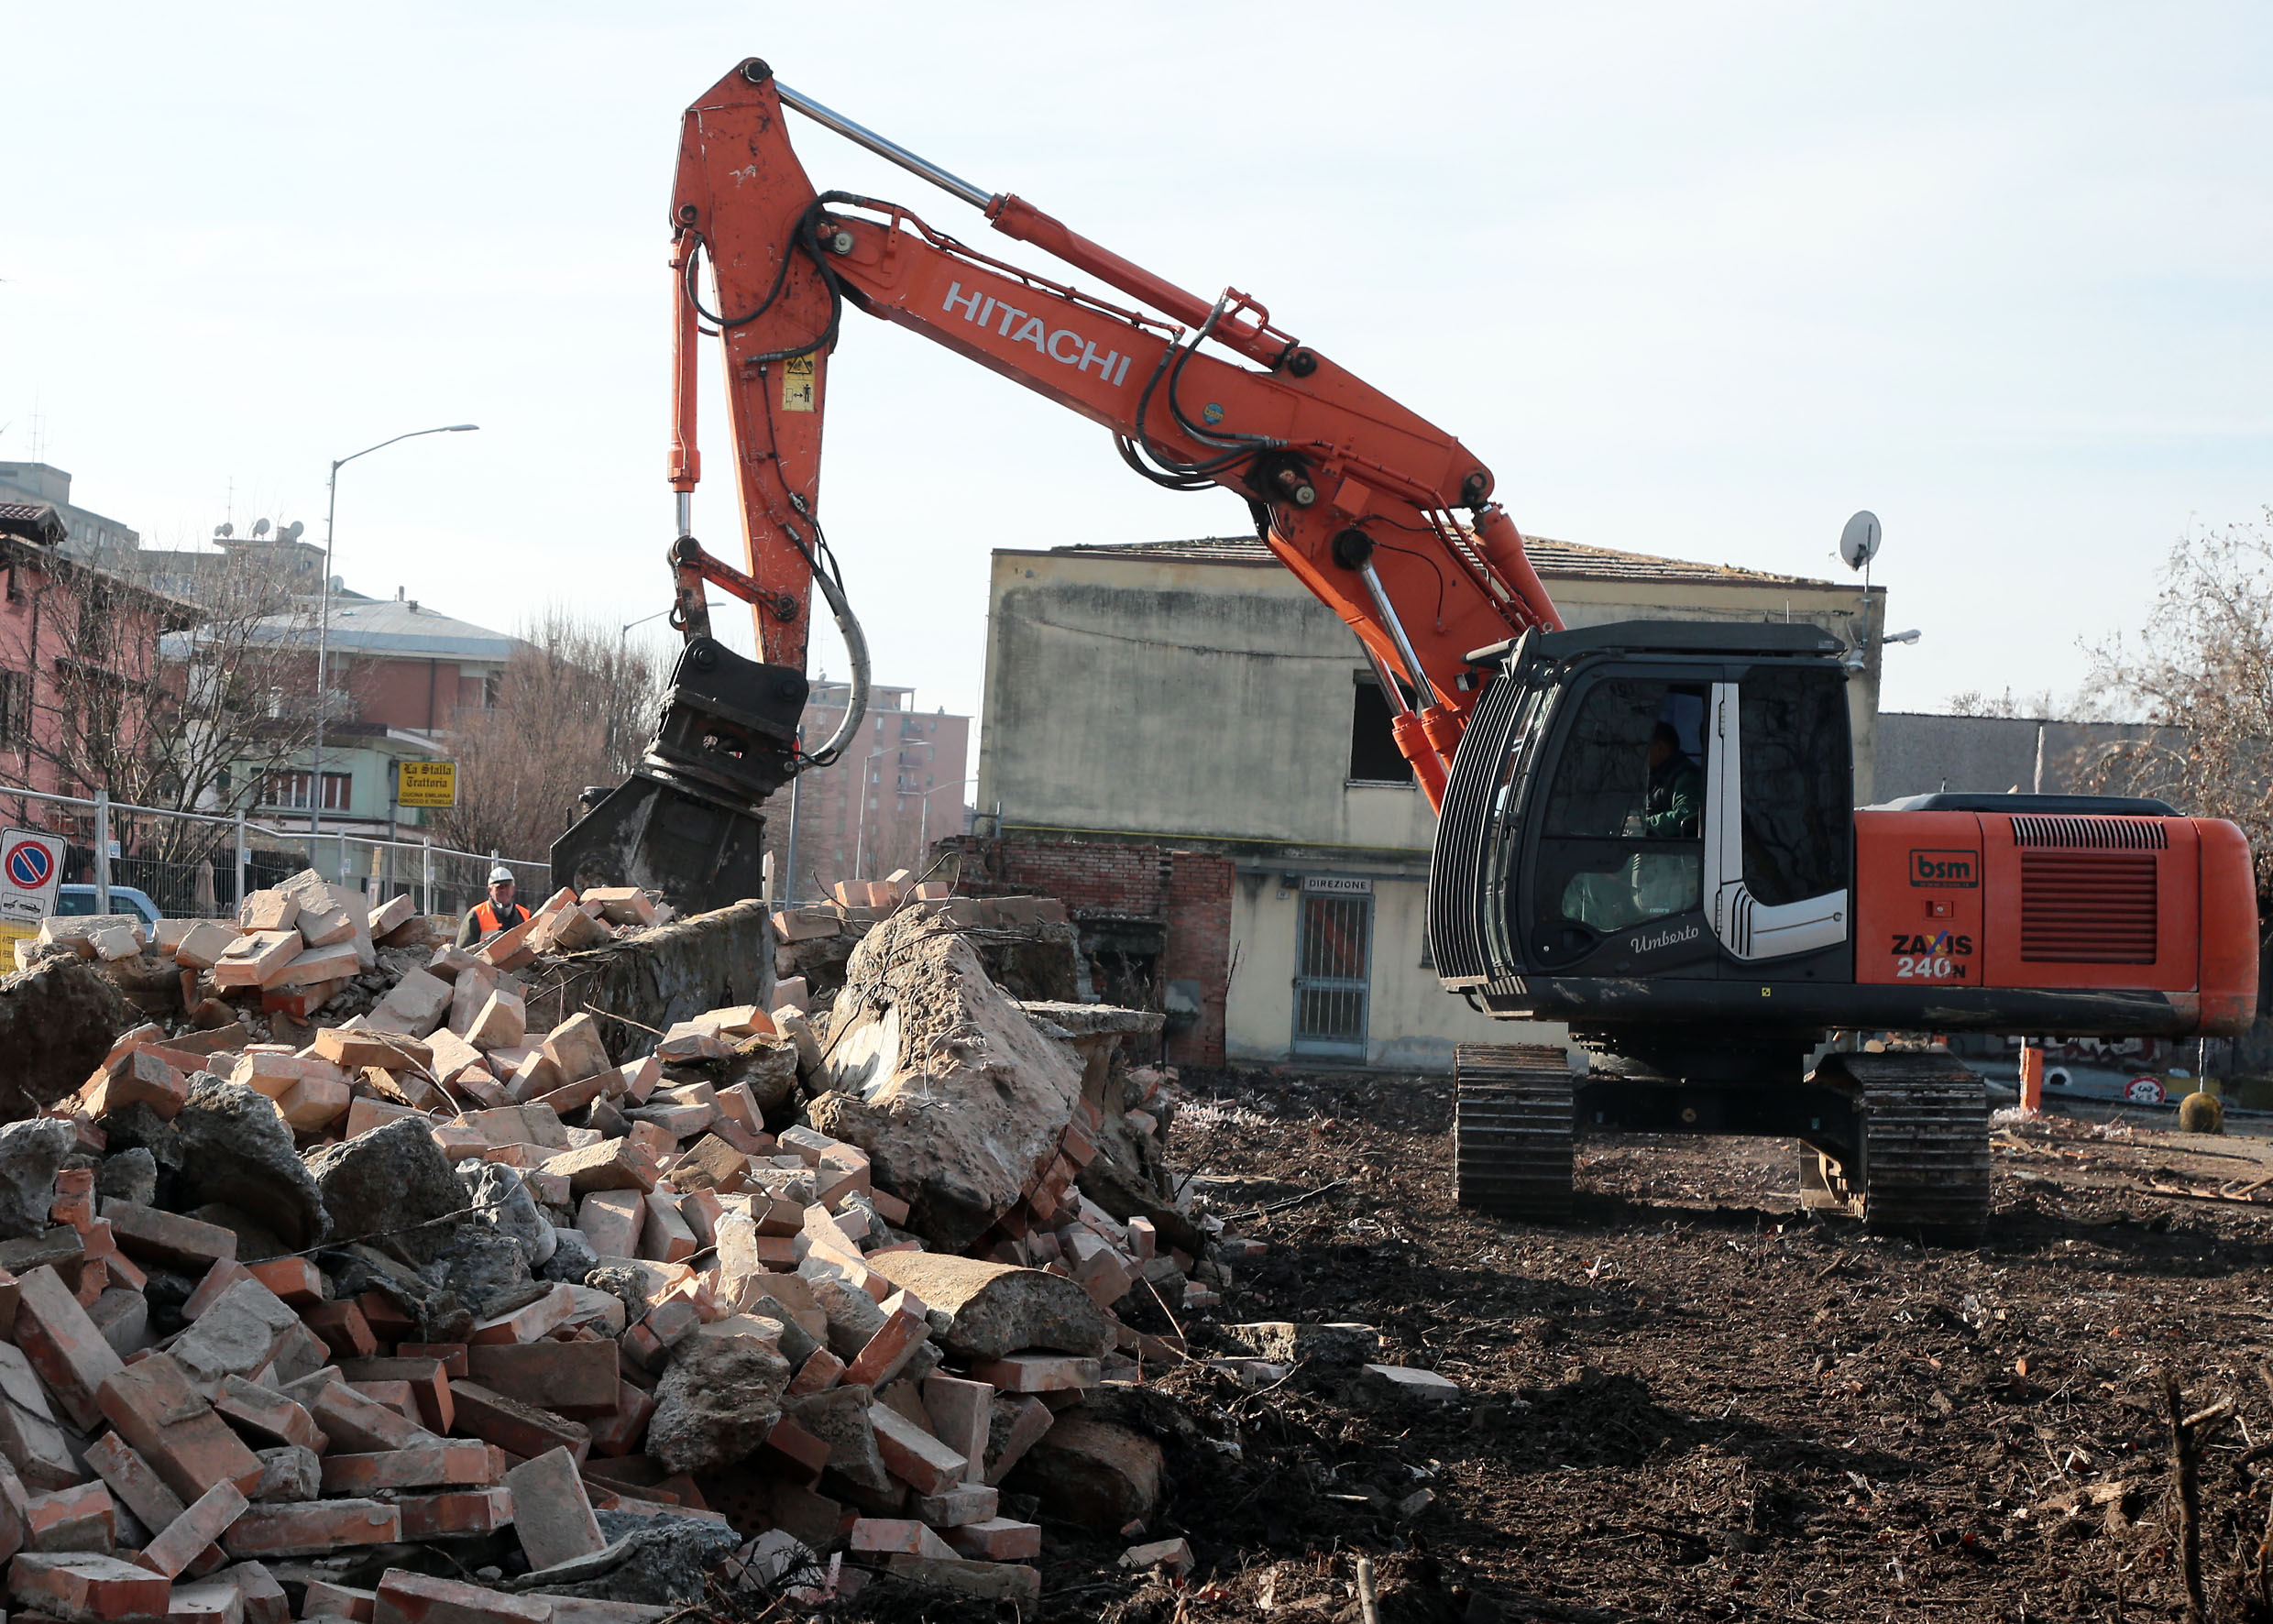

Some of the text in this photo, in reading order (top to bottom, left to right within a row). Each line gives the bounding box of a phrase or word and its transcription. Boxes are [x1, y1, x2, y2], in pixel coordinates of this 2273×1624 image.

[942, 280, 1132, 387] HITACHI
[404, 763, 451, 775] La Stalla
[406, 776, 447, 788] Trattoria
[1917, 855, 1970, 879] bsm
[1309, 879, 1367, 890] DIREZIONE
[1631, 925, 1699, 954] Umberto
[1891, 930, 1973, 956] ZAXIS
